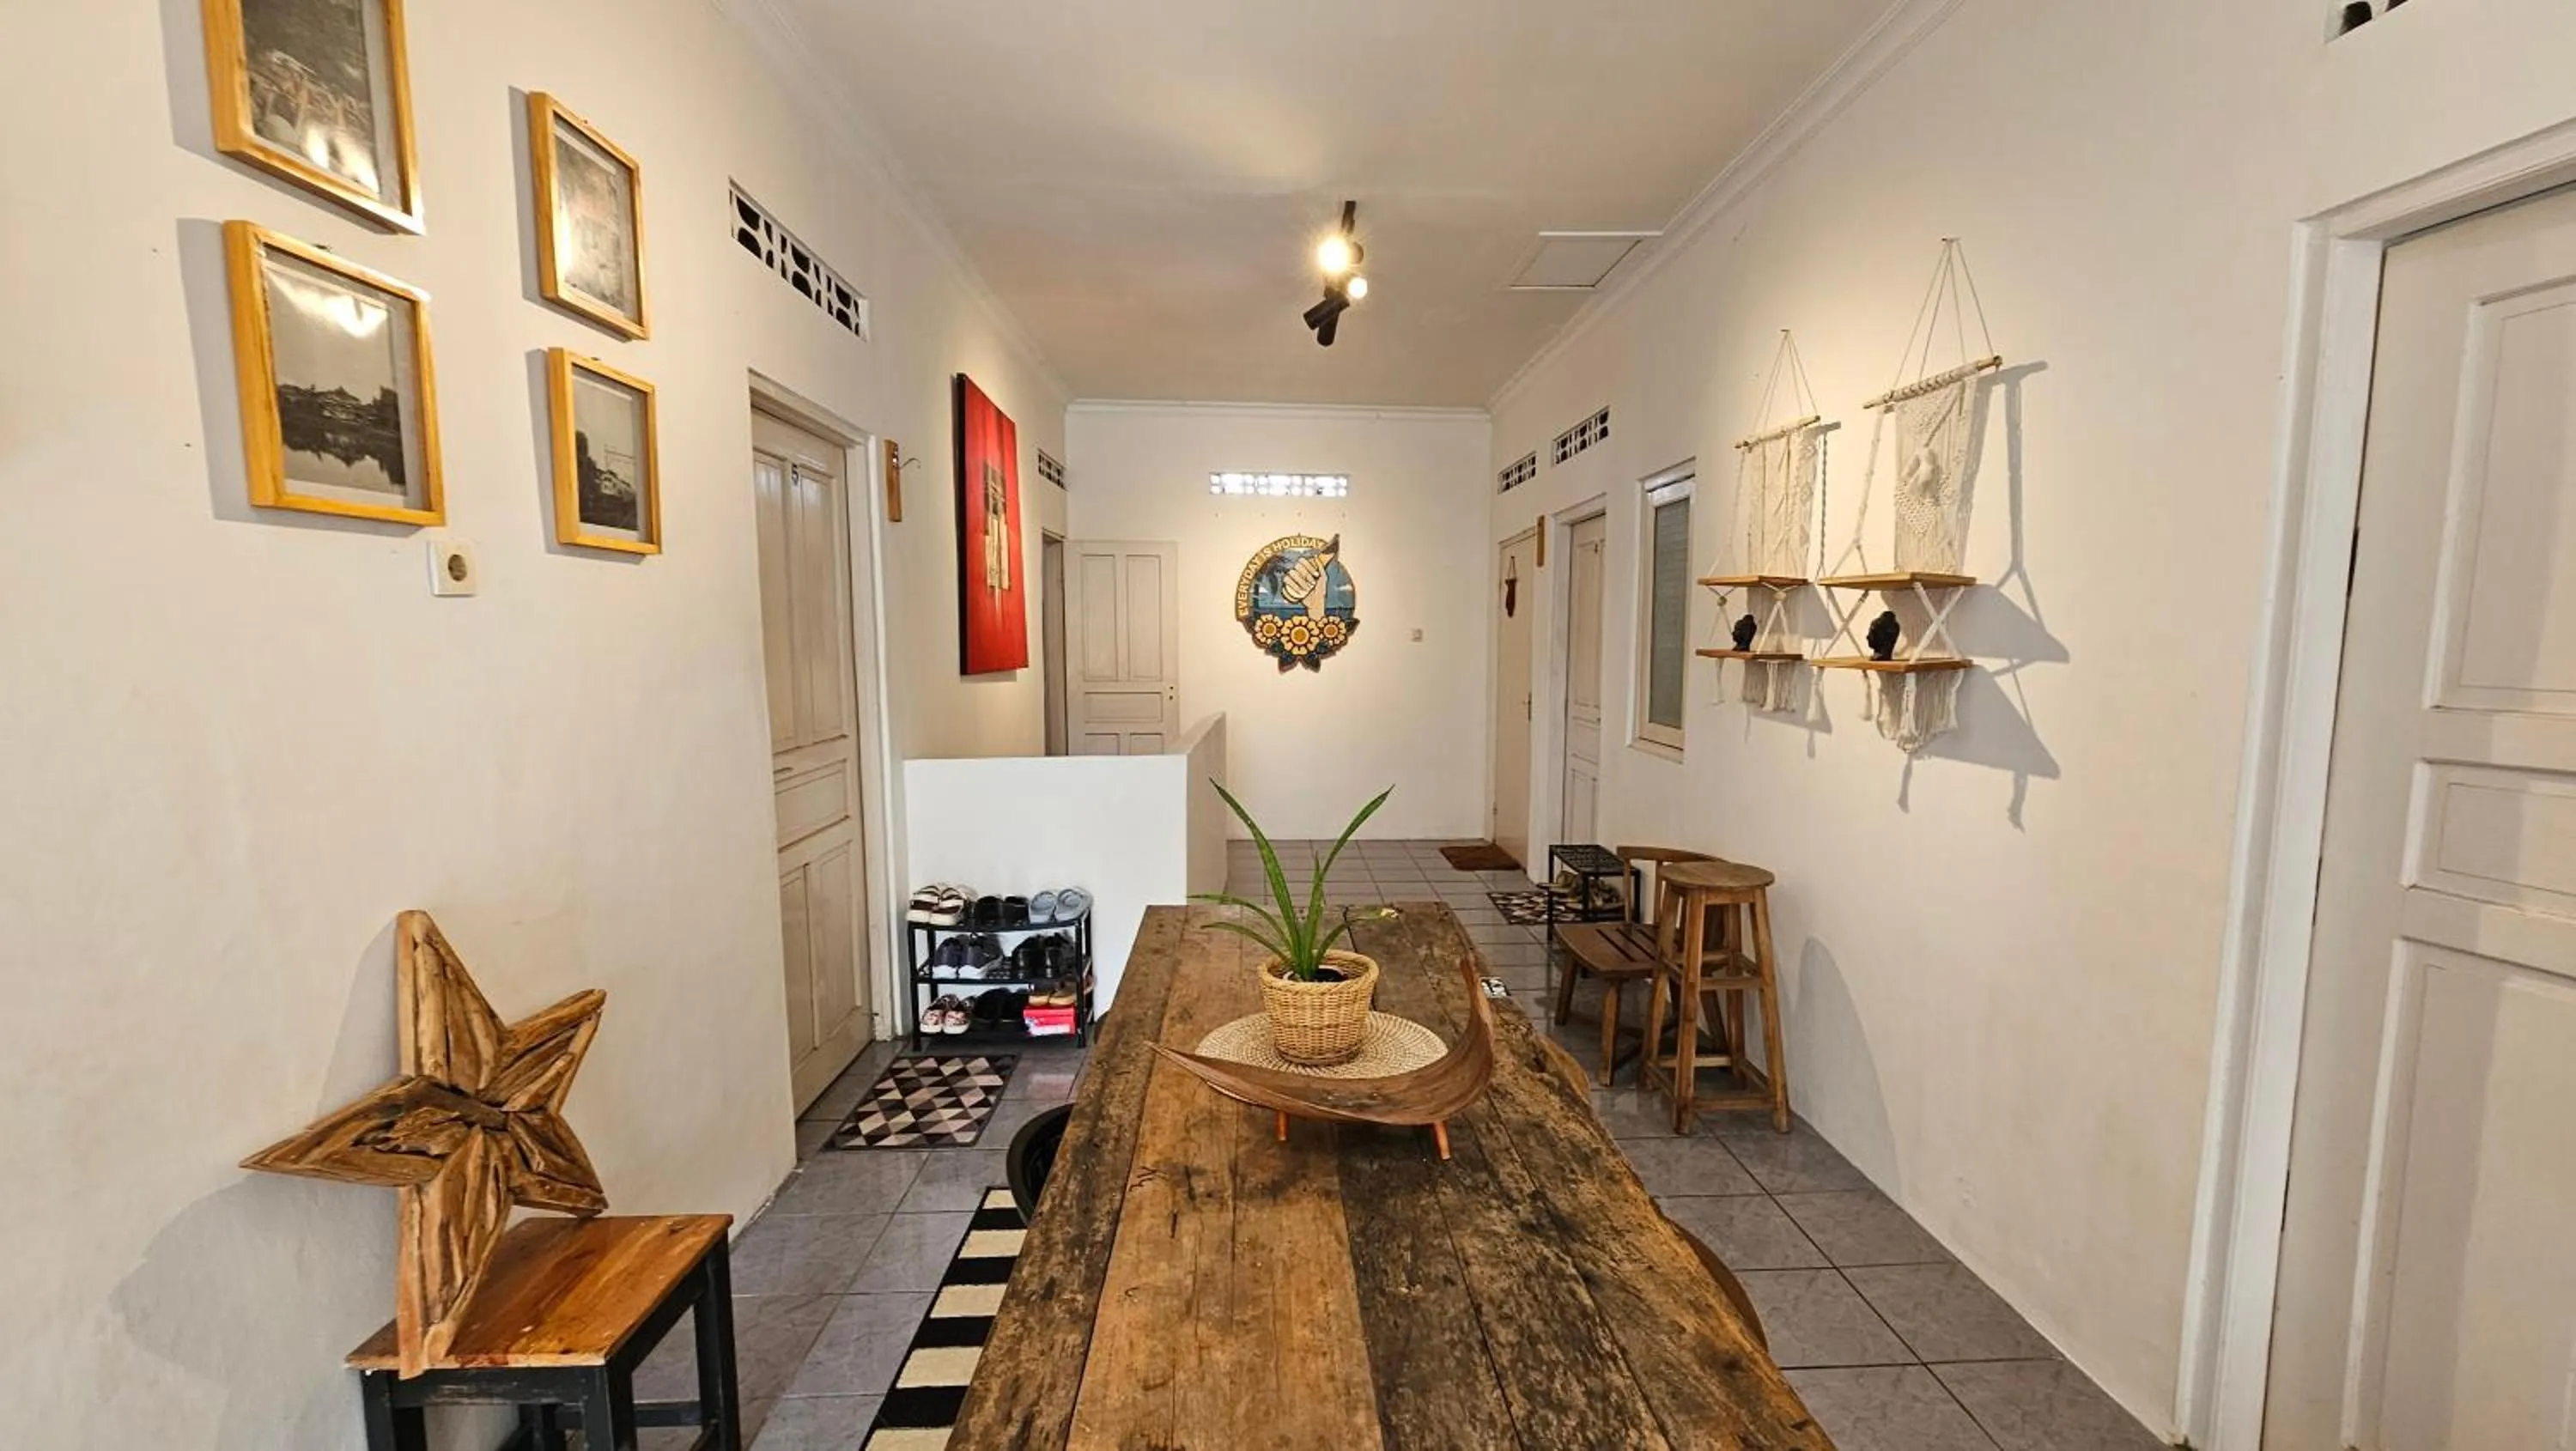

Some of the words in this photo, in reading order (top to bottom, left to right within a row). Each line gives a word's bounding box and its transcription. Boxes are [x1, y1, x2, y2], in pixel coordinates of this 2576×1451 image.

[1237, 556, 1261, 616] EVERYDAY
[1261, 548, 1272, 562] IS
[1273, 537, 1324, 550] HOLIDAY
